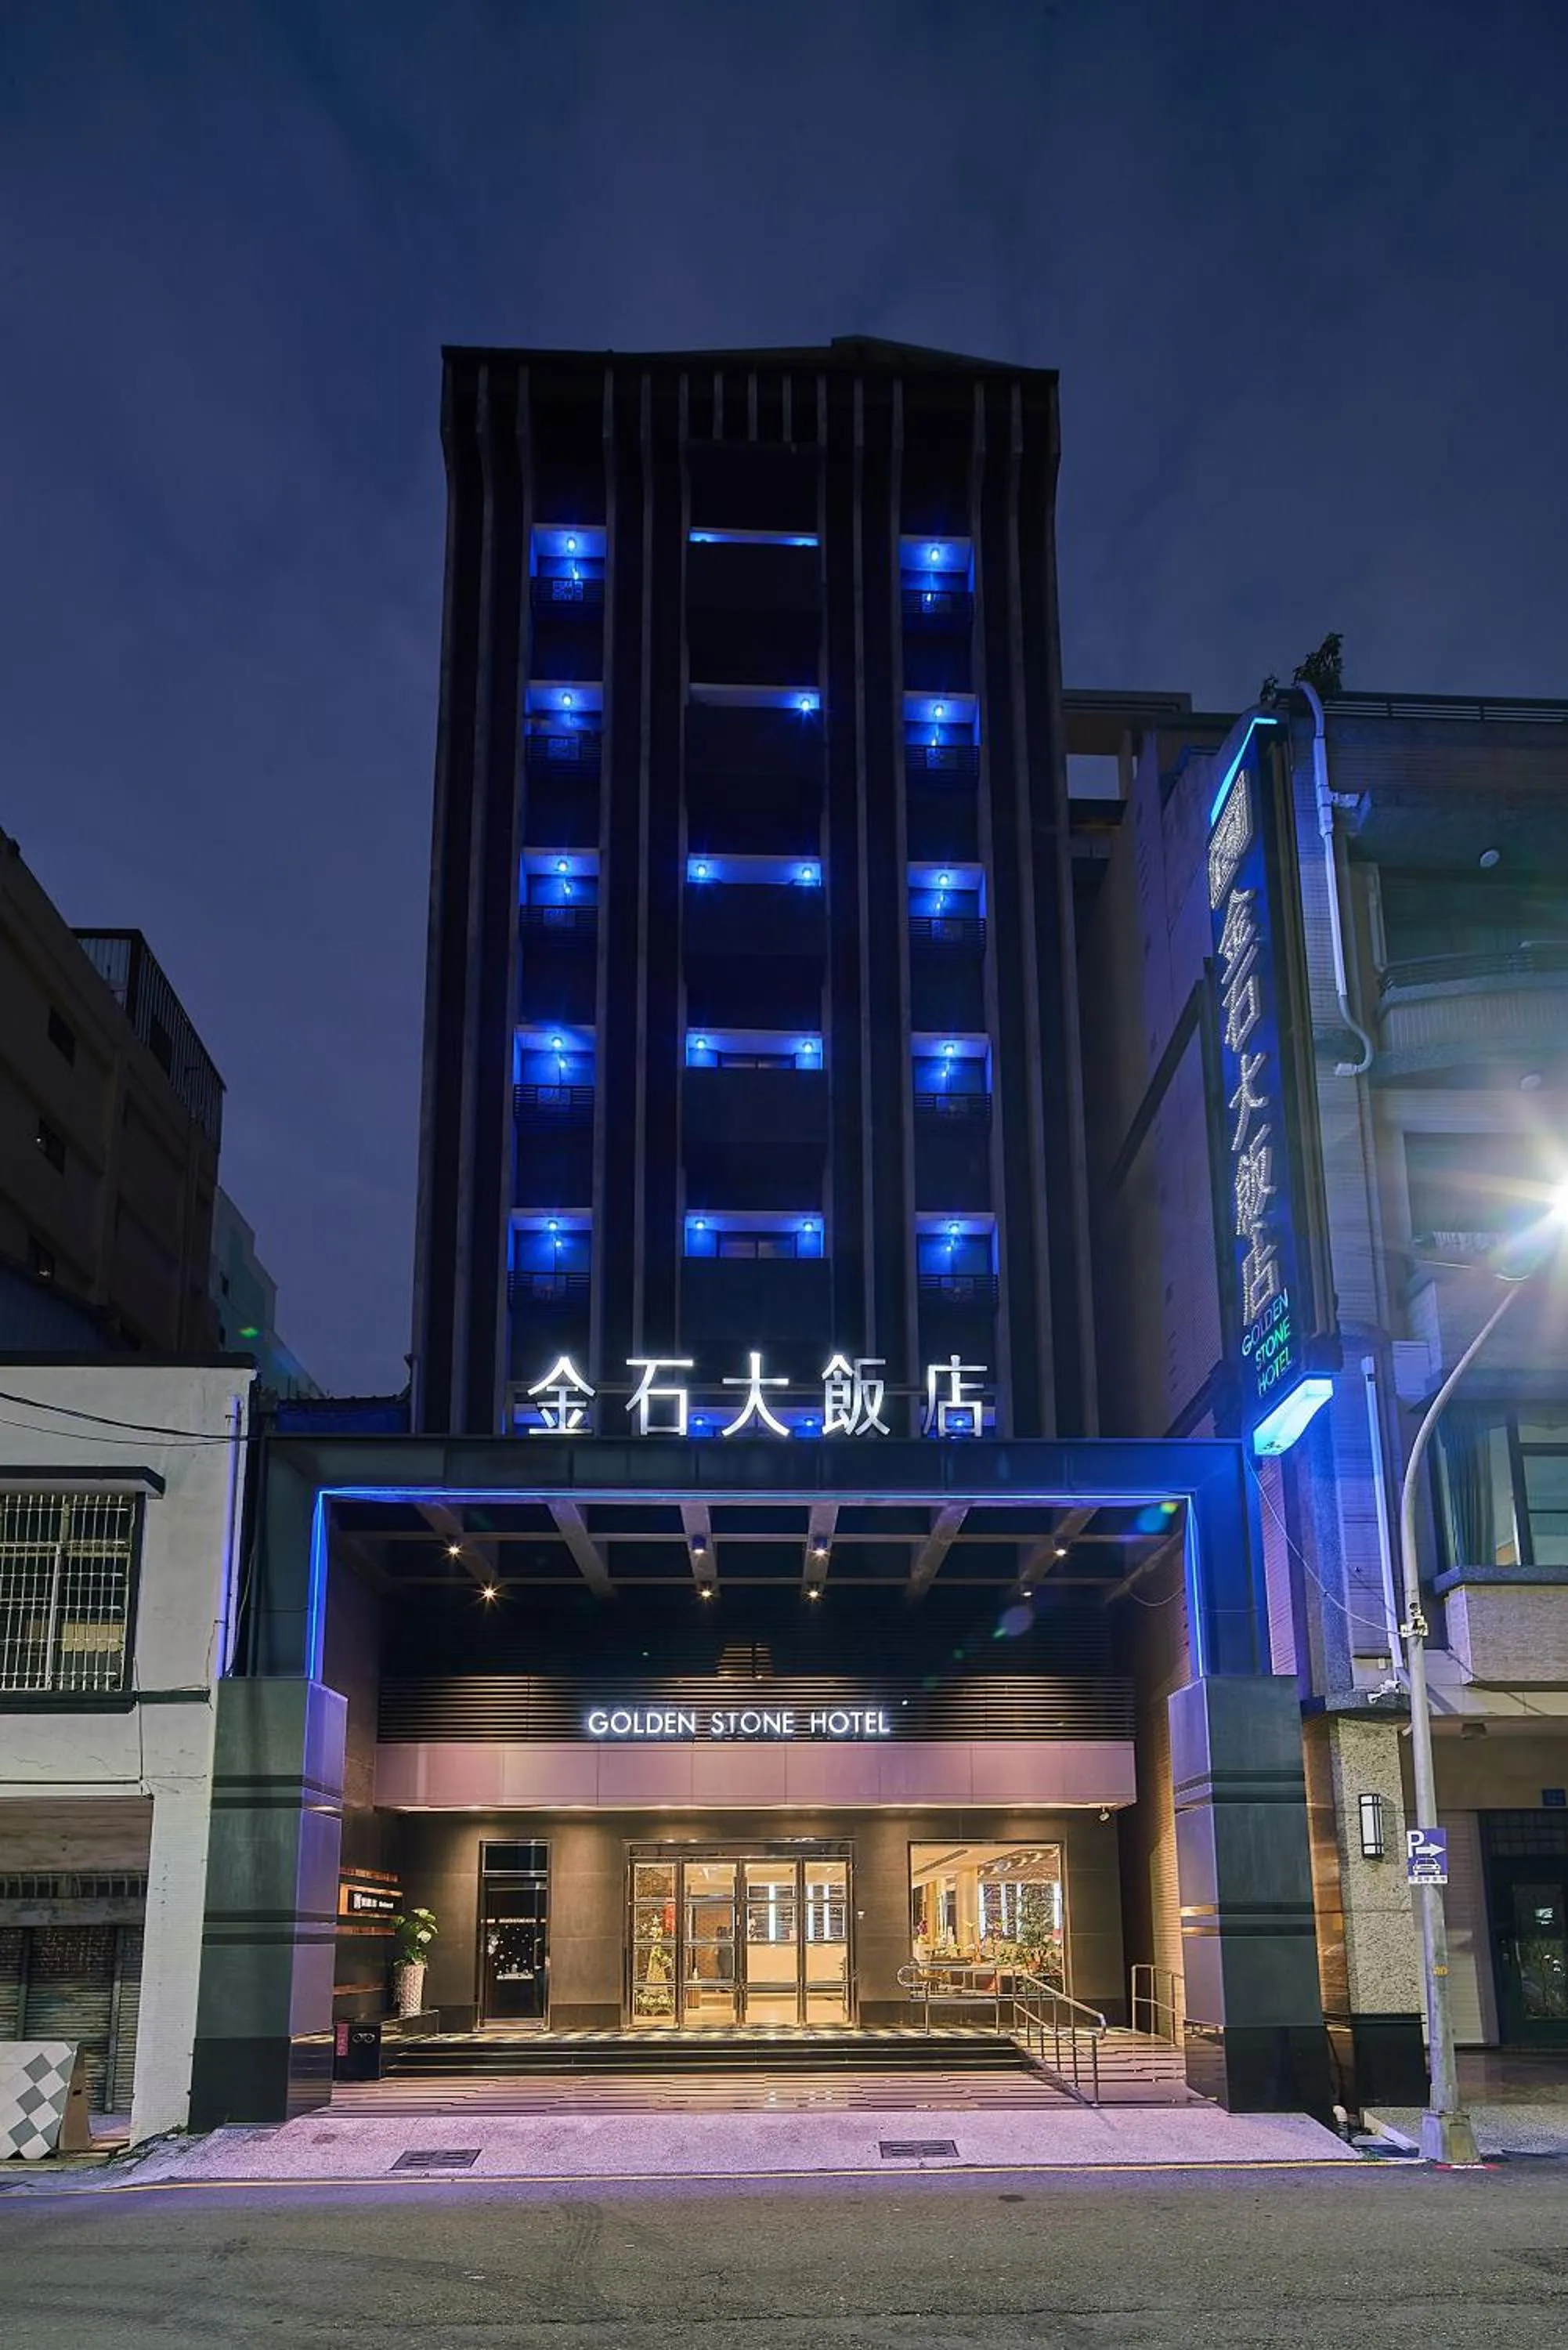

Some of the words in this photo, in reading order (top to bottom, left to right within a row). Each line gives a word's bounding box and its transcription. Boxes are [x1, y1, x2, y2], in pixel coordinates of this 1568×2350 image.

[1219, 889, 1279, 1325] 金石大飯店
[1242, 1287, 1288, 1356] GOLDEN
[1255, 1316, 1291, 1371] STONE
[527, 1351, 988, 1437] 金石大飯店
[1258, 1347, 1292, 1397] HOTEL
[587, 1711, 696, 1734] GOLDEN
[711, 1712, 795, 1734] STONE
[810, 1712, 891, 1734] HOTEL
[1407, 1831, 1425, 1858] P
